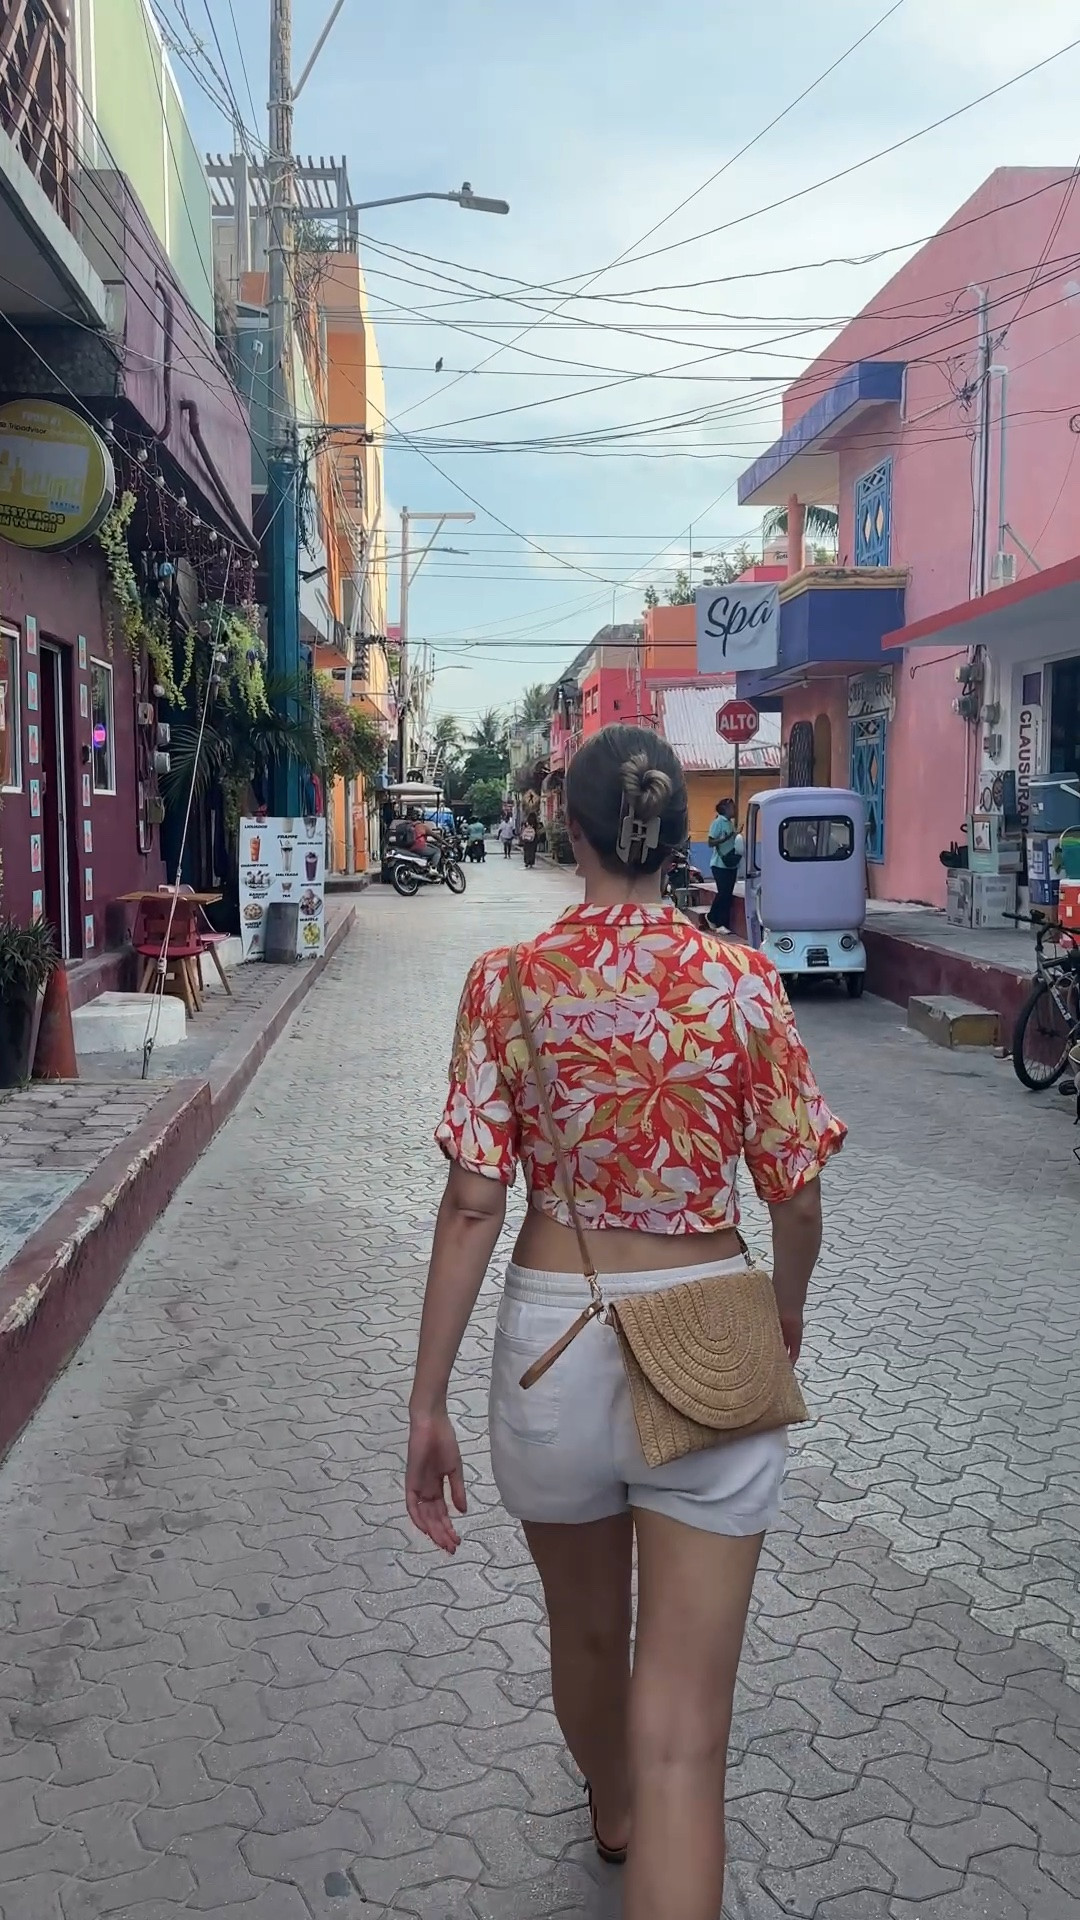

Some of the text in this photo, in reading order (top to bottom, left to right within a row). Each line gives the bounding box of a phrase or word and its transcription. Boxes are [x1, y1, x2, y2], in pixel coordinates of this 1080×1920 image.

[27, 508, 65, 524] TACOS
[704, 596, 775, 658] Spa
[719, 713, 757, 731] ALTO
